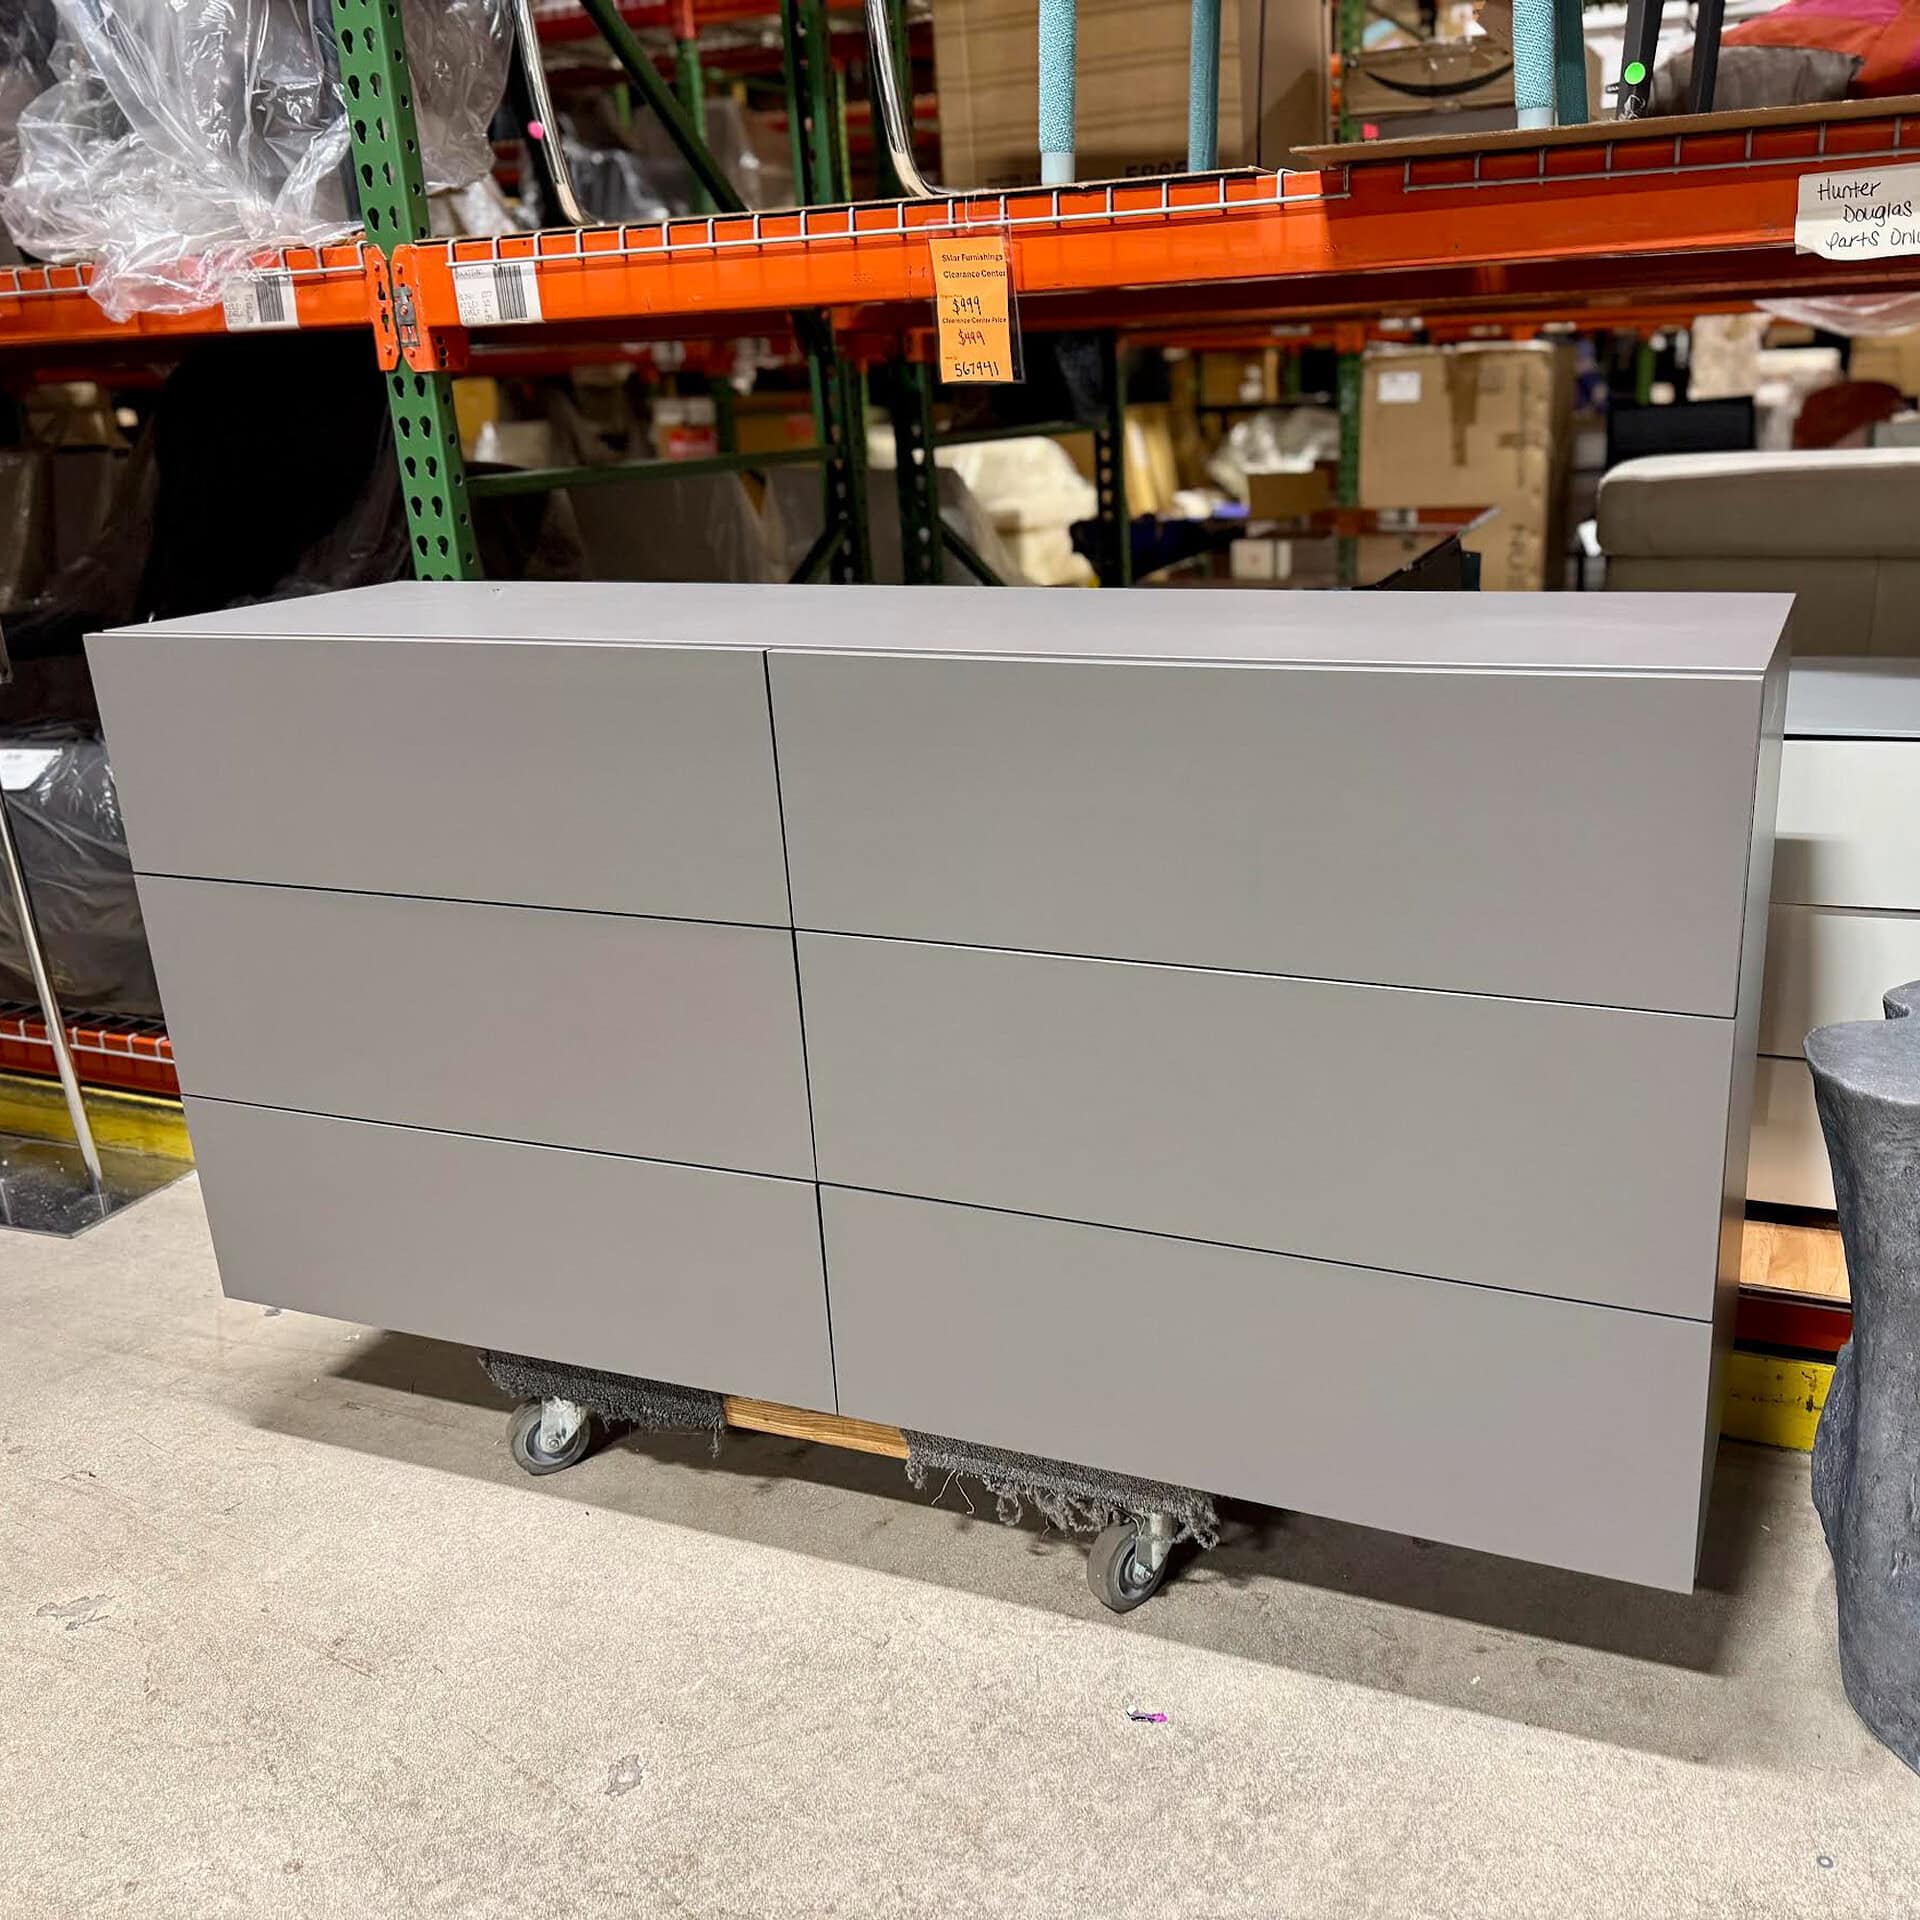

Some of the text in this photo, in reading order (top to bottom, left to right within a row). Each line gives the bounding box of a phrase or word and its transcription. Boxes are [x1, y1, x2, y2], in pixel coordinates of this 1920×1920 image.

[1817, 177, 1882, 201] Hunter
[1842, 200, 1913, 228] Douglas
[1825, 230, 1881, 251] Parts
[961, 253, 1003, 262] Furnishings
[943, 269, 1006, 279] Clearance Center
[952, 295, 982, 316] $999
[954, 361, 1000, 377] 567941
